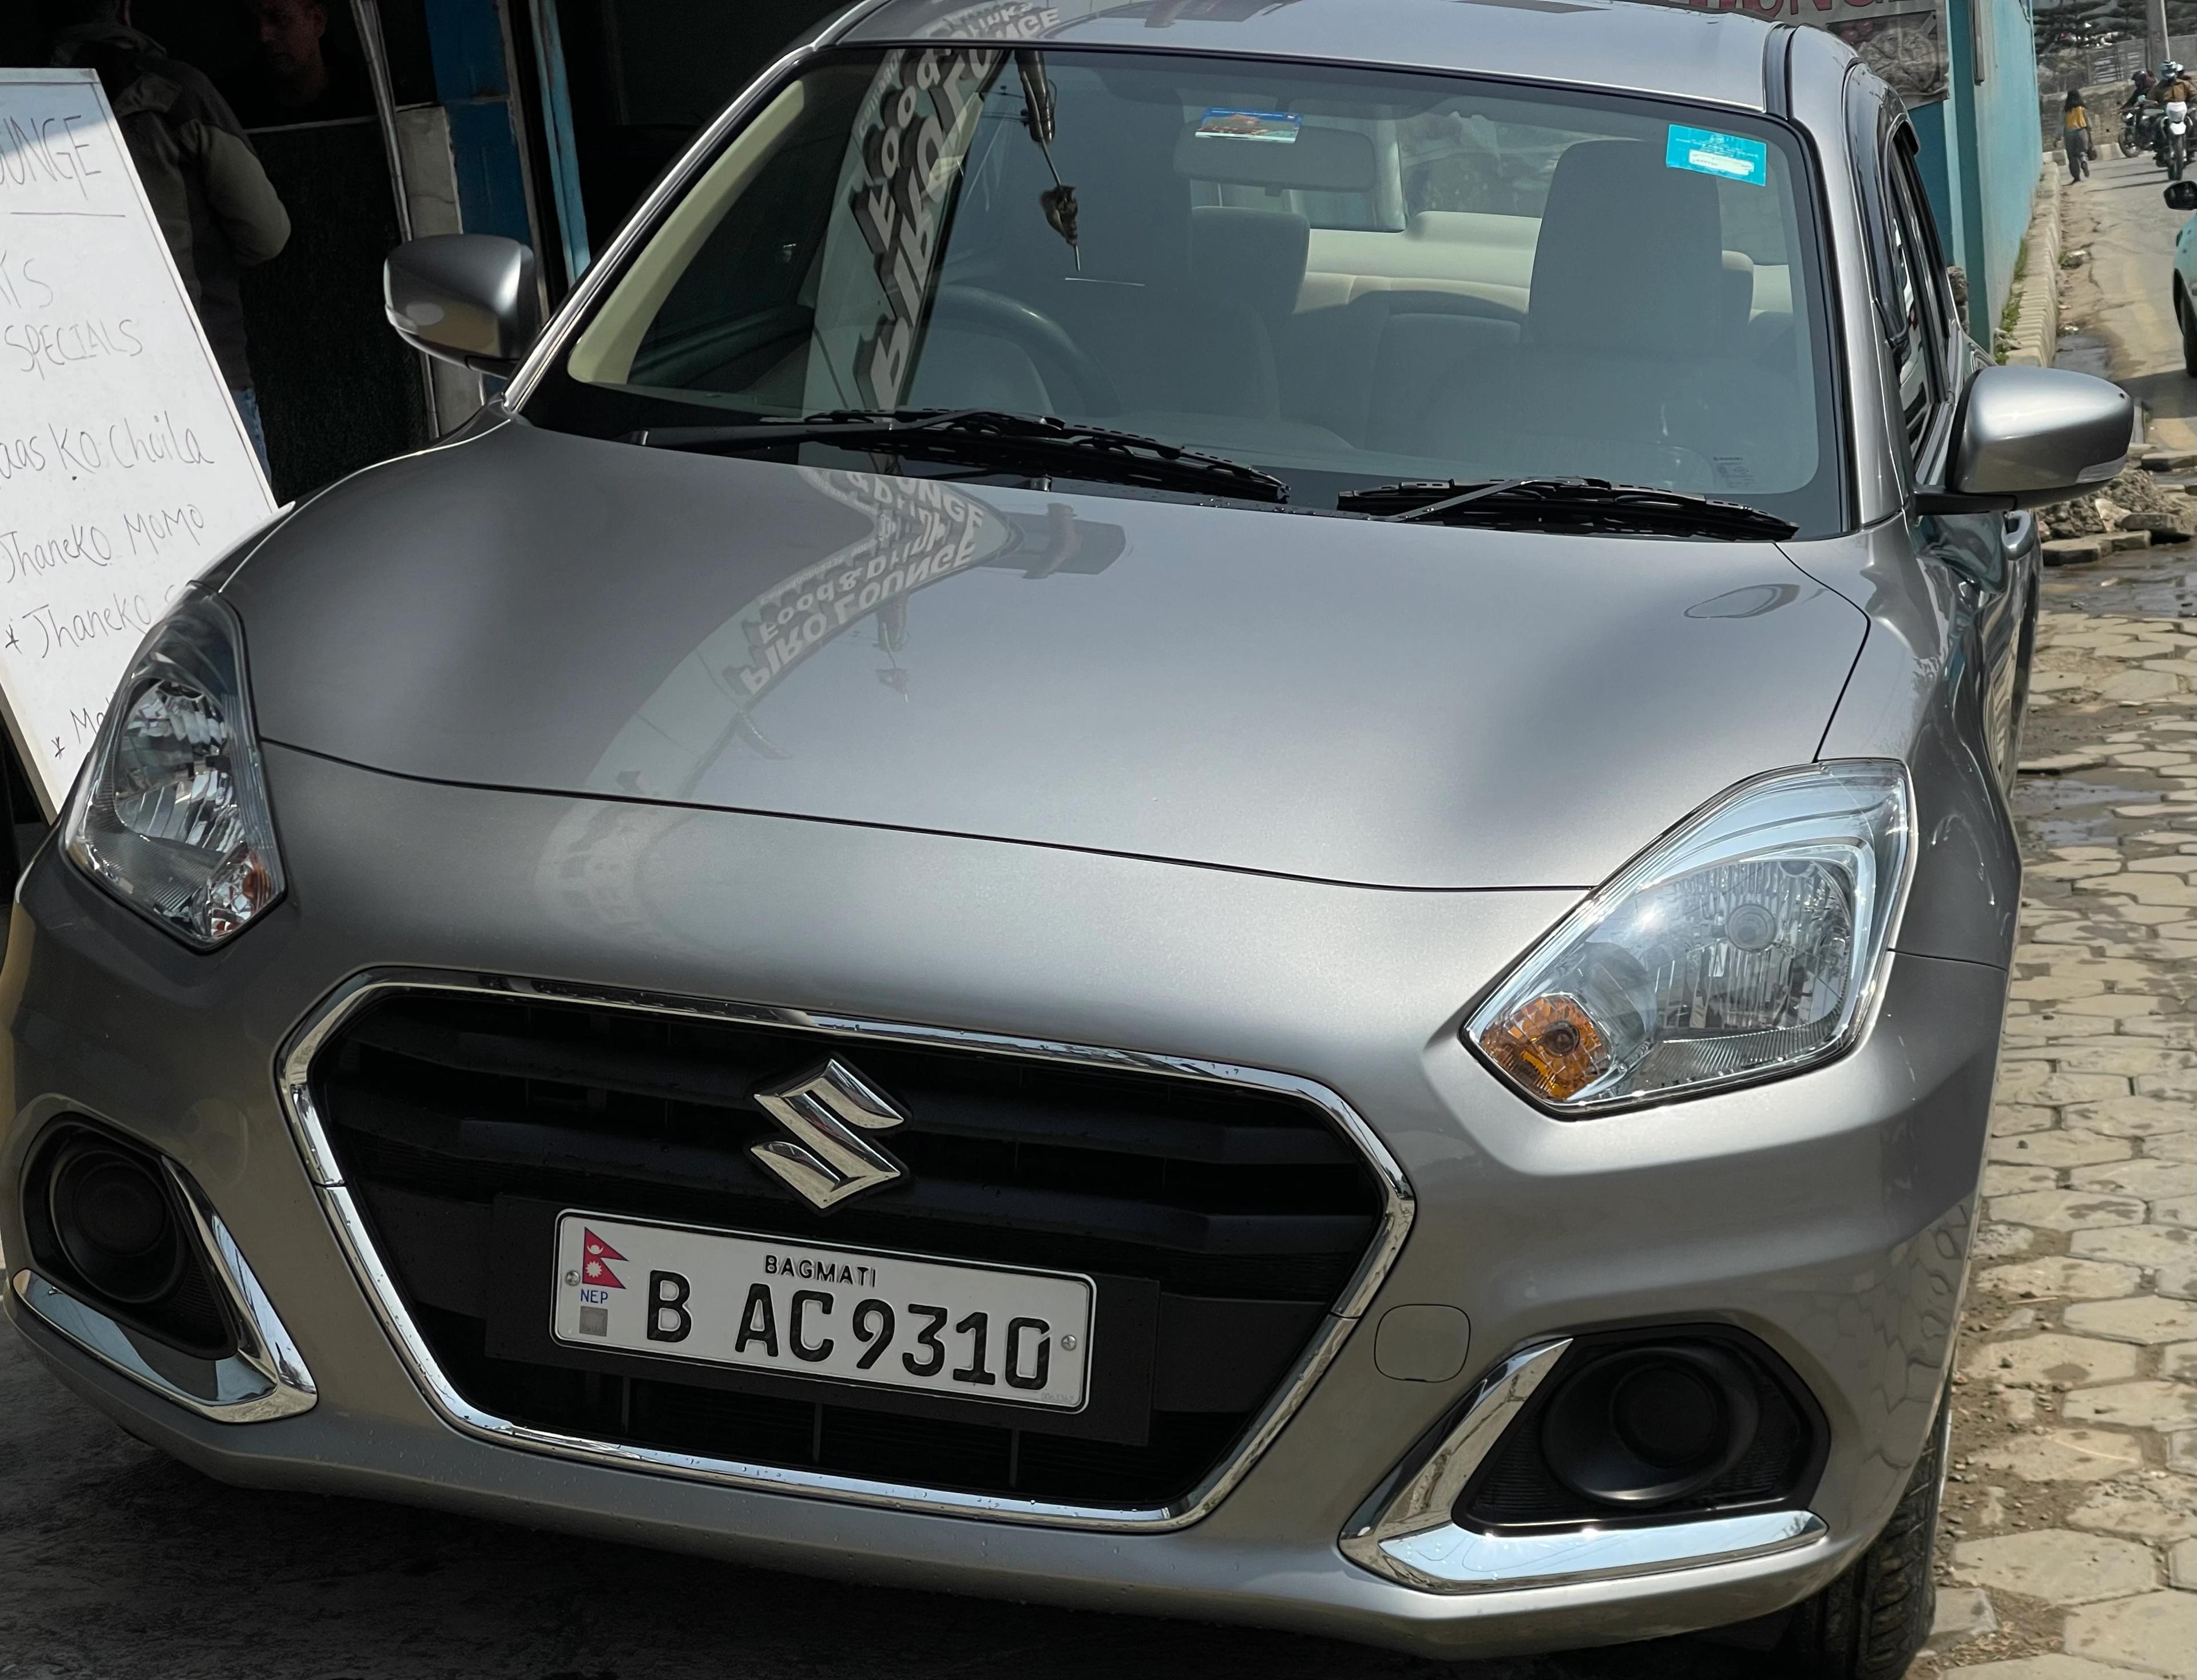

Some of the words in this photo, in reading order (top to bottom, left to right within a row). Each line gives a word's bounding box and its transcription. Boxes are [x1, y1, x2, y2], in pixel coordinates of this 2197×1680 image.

[0, 116, 102, 201] UNGE
[4, 318, 143, 381] SPECIALS
[580, 1289, 609, 1305] NEP
[763, 1254, 878, 1288] BAGMATI
[647, 1269, 692, 1343] B
